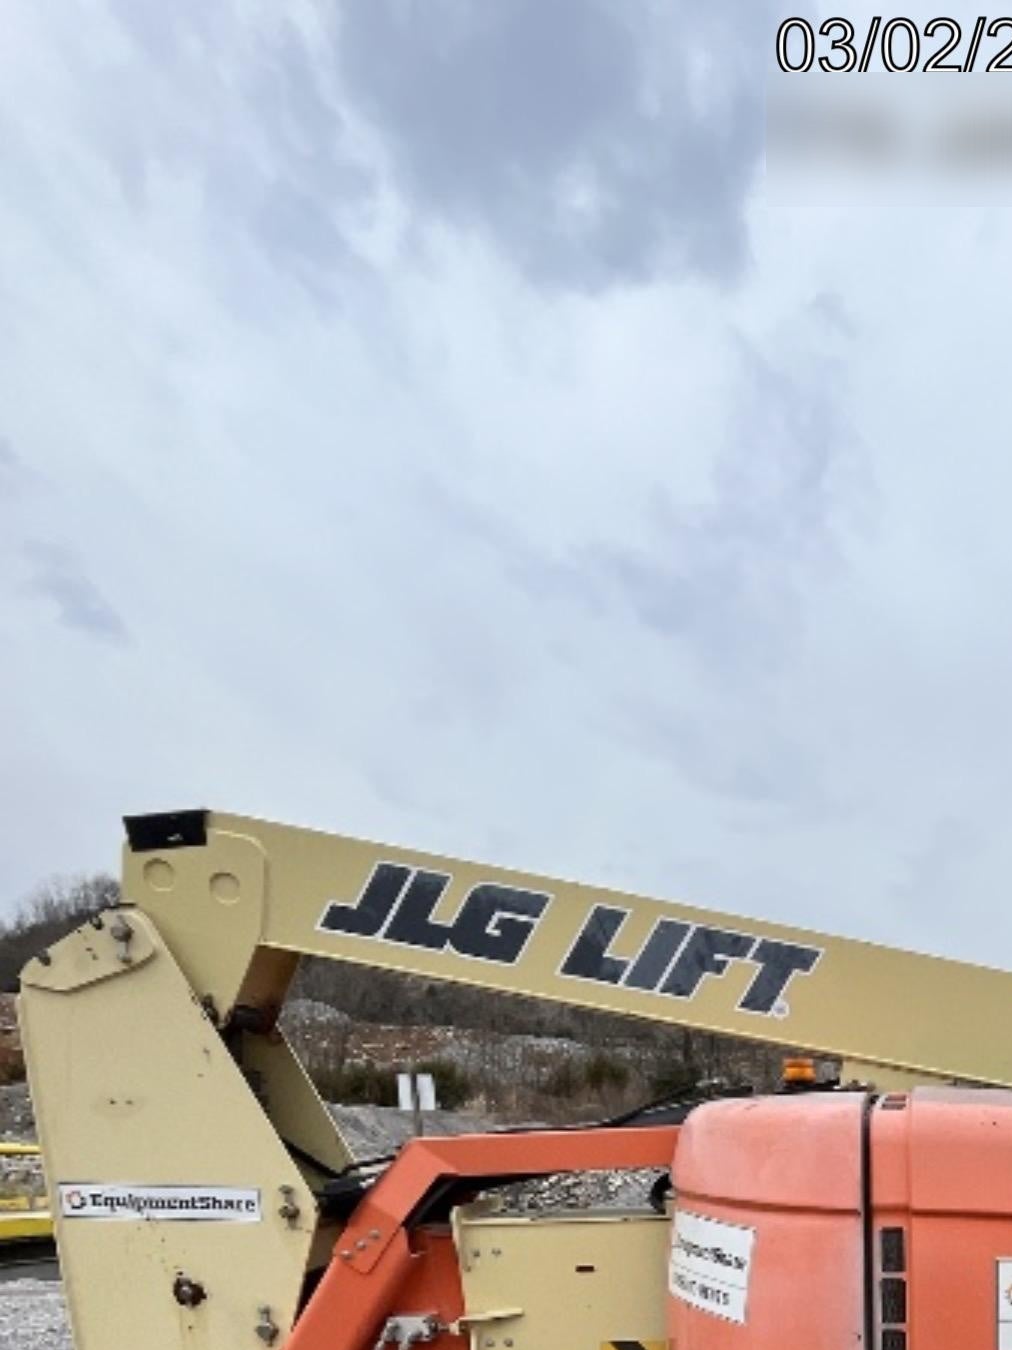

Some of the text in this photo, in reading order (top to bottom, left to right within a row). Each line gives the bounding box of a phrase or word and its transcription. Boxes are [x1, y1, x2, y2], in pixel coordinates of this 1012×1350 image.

[316, 860, 825, 1015] JLG LIFT
[90, 1192, 256, 1213] EquipmentShare
